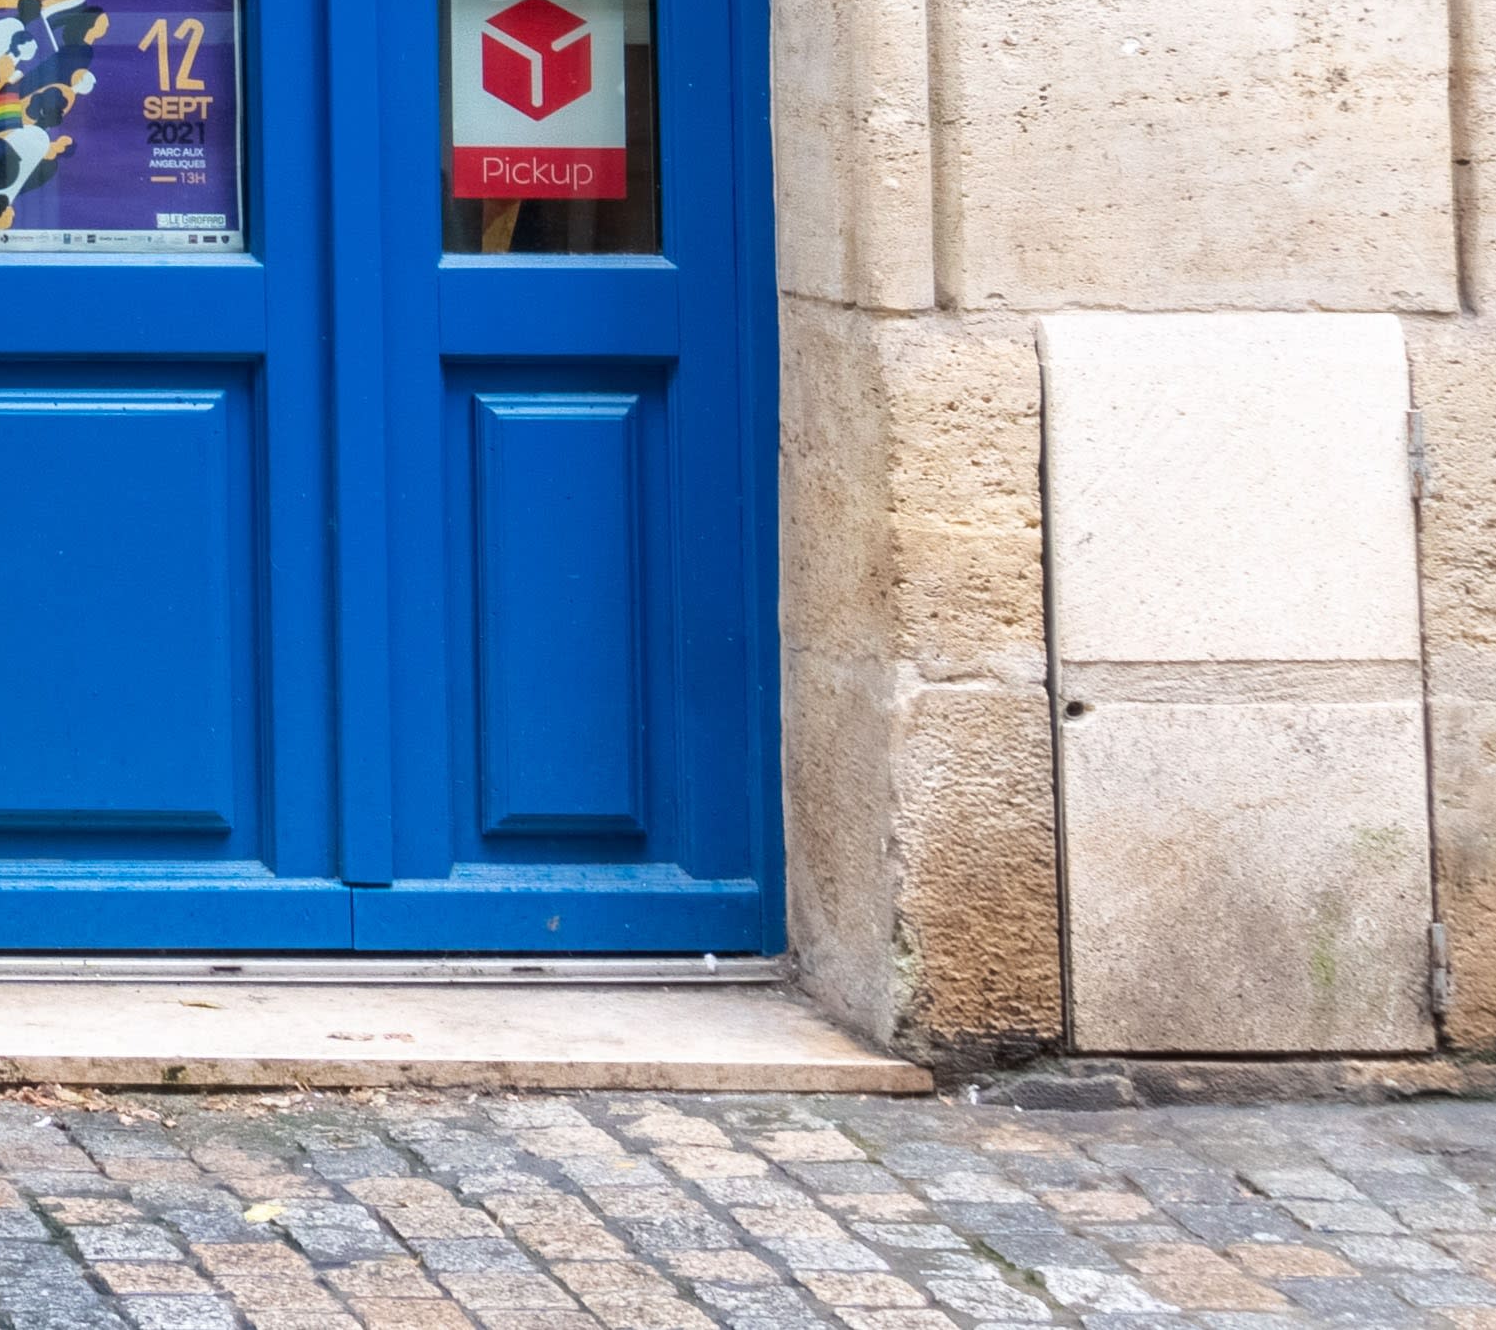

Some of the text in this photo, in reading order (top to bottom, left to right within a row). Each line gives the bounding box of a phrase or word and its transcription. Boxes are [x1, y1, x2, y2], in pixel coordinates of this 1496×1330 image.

[138, 19, 206, 93] 12
[143, 96, 213, 120] SEPT
[146, 121, 206, 145] 2021
[153, 148, 204, 157] PARC AUX
[179, 172, 206, 184] 13H
[483, 156, 593, 191] Pickup
